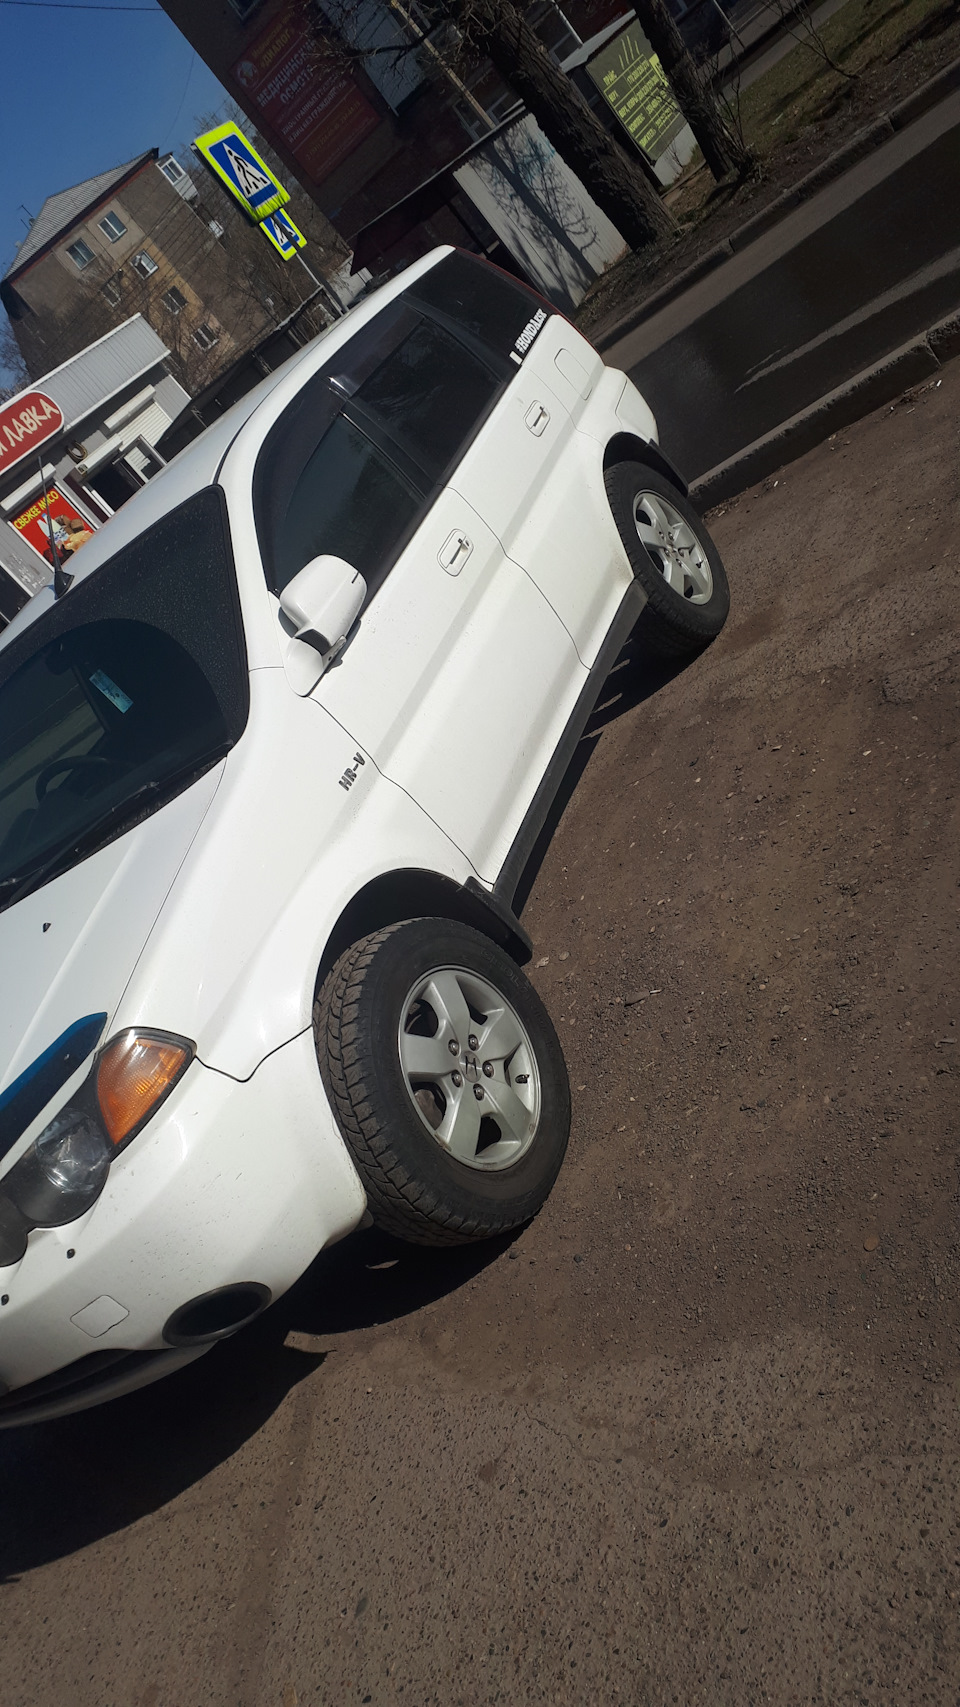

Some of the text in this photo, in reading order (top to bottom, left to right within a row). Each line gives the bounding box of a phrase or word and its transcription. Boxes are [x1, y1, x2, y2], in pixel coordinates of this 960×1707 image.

[3, 399, 59, 447] ЛАВКА
[14, 505, 41, 529] СВЕЖЕЕ
[339, 752, 365, 791] HR-V
